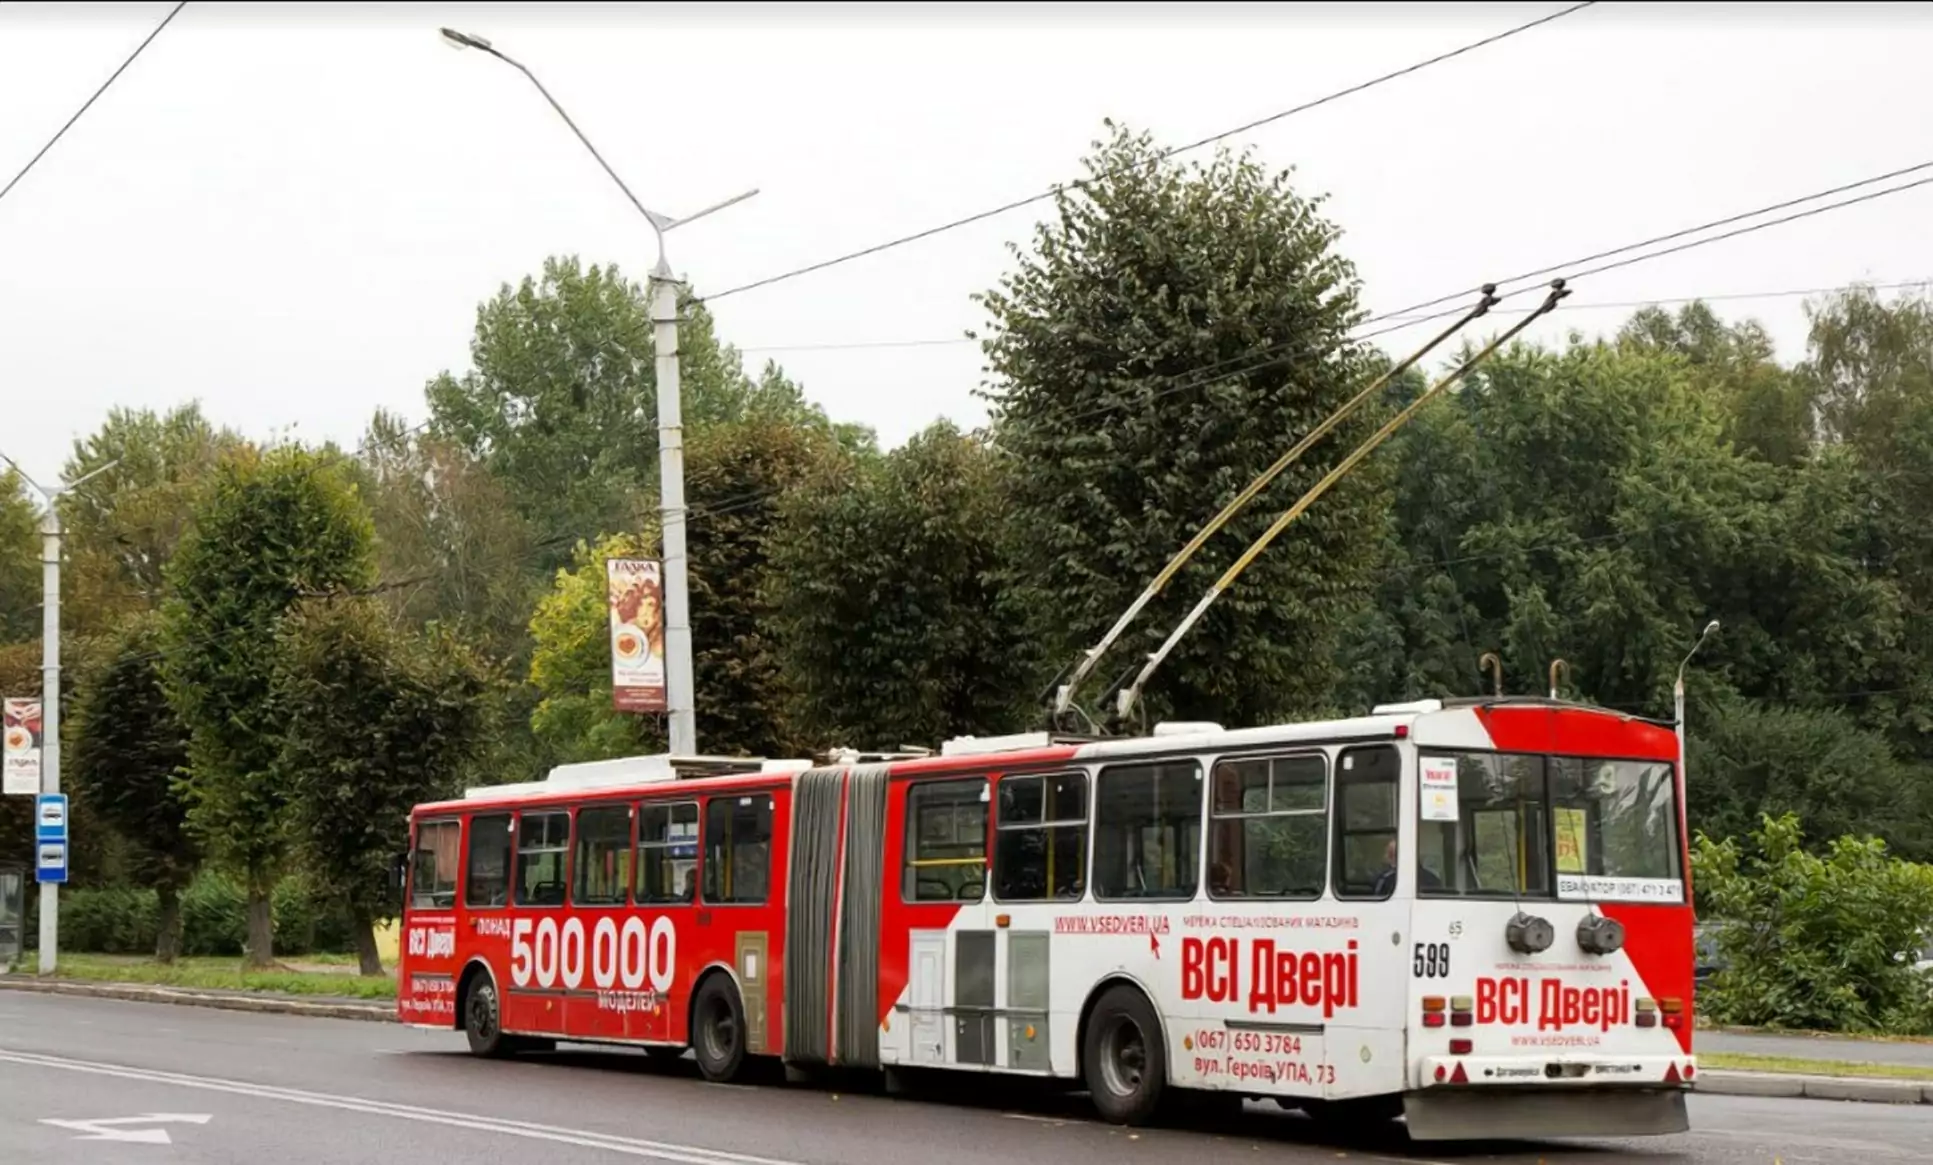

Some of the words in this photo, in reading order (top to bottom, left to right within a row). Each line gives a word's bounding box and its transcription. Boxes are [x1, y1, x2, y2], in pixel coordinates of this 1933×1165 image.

[1055, 916, 1170, 934] WWW.VSEDVERI.UA
[511, 916, 585, 990] 500
[593, 915, 676, 992] 000
[1413, 943, 1450, 978] 599
[1182, 937, 1239, 1003] ВСІ
[1249, 938, 1358, 1018] Двері
[1477, 977, 1529, 1025] ВСІ
[1538, 978, 1629, 1032] Двері
[1195, 1030, 1231, 1053] (067)
[1234, 1033, 1261, 1051] 650
[1264, 1035, 1301, 1054] 3784
[1317, 1065, 1336, 1084] 73
